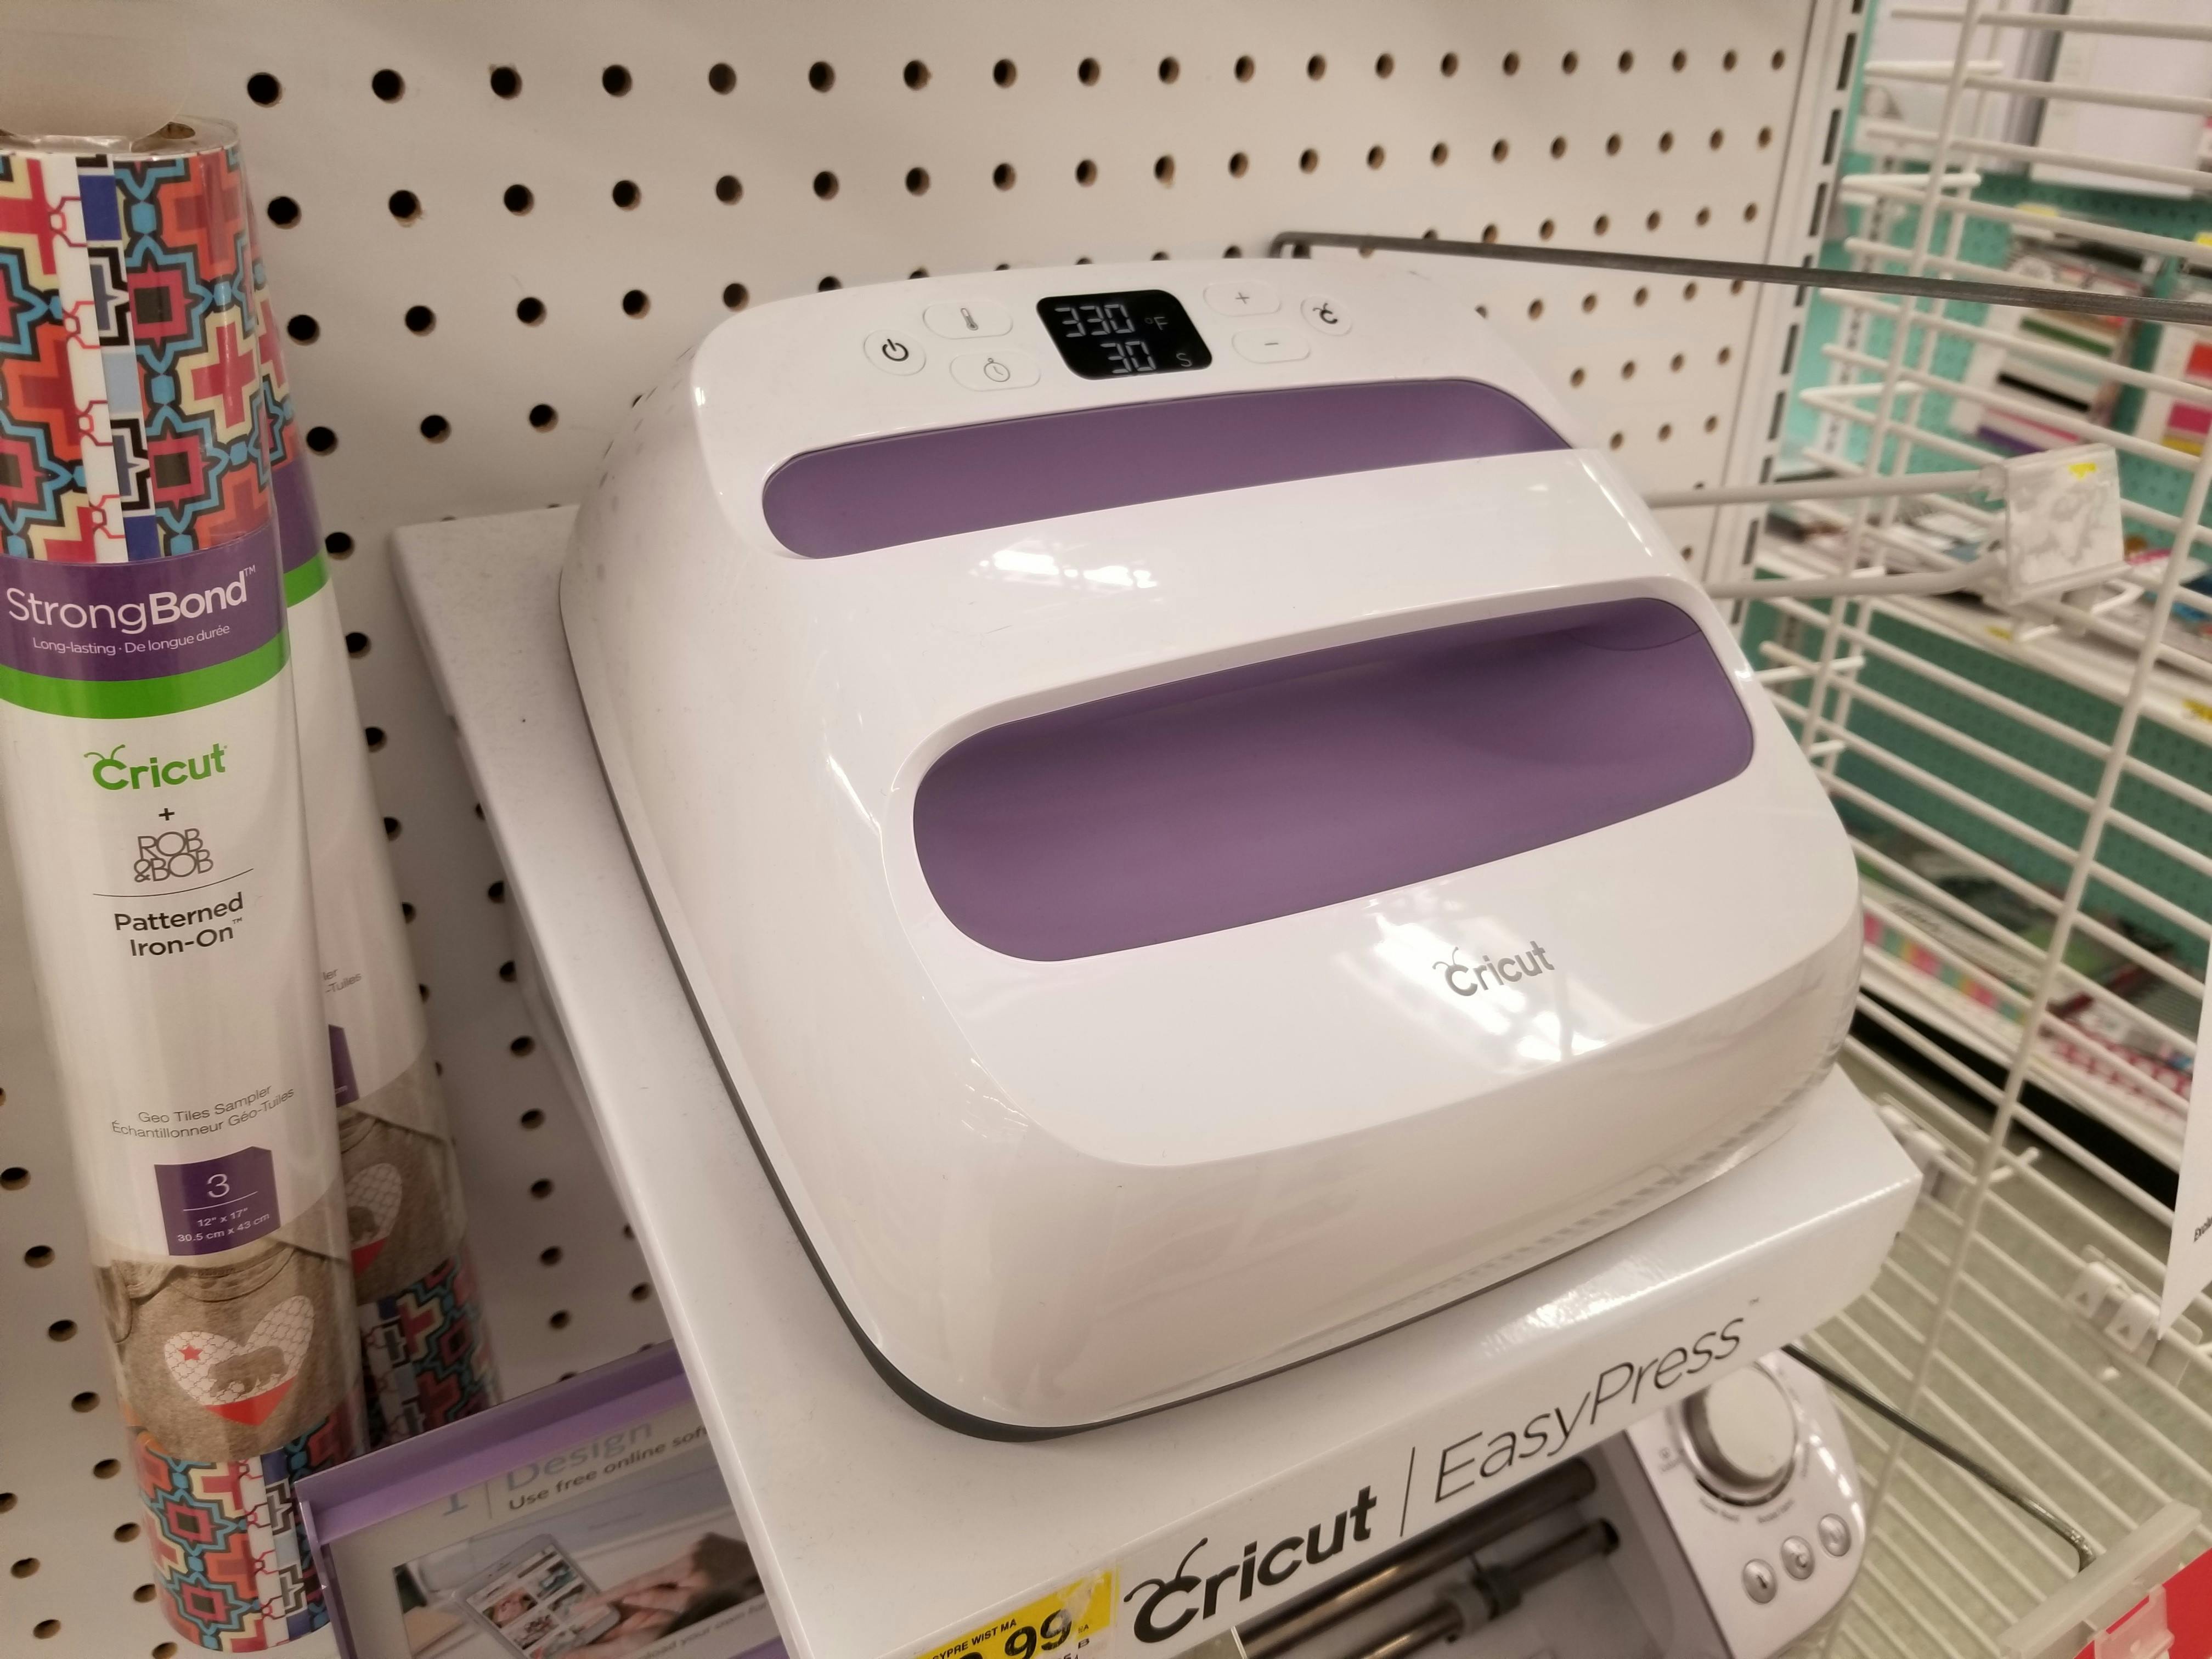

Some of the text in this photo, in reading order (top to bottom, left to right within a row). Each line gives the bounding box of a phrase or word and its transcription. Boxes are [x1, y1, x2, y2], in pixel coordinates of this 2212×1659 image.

[1054, 303, 1135, 338] 330
[1099, 340, 1156, 374] 30
[7, 571, 247, 635] StrongBond
[33, 624, 231, 656] Long-lasting De longue durée
[84, 743, 226, 791] Cricut
[137, 827, 204, 860] ROB
[114, 891, 245, 932] Patterned
[129, 925, 234, 957] Iron-On
[1432, 940, 1555, 997] Cricut
[112, 1088, 295, 1138] Échantillonneur Géo-Tuiles
[138, 1085, 272, 1123] Geo Tiles Sampler
[207, 1173, 230, 1198] 3
[178, 1233, 204, 1242] 30.5
[206, 1230, 225, 1239] cm
[237, 1221, 251, 1231] 43
[253, 1213, 270, 1225] cm
[509, 1488, 549, 1510] Use
[556, 1469, 599, 1493] free
[603, 1442, 667, 1474] online
[1124, 1317, 1744, 1644] Cricut EasyPress
[972, 1627, 998, 1646] WIST
[1001, 1618, 1018, 1633] MA
